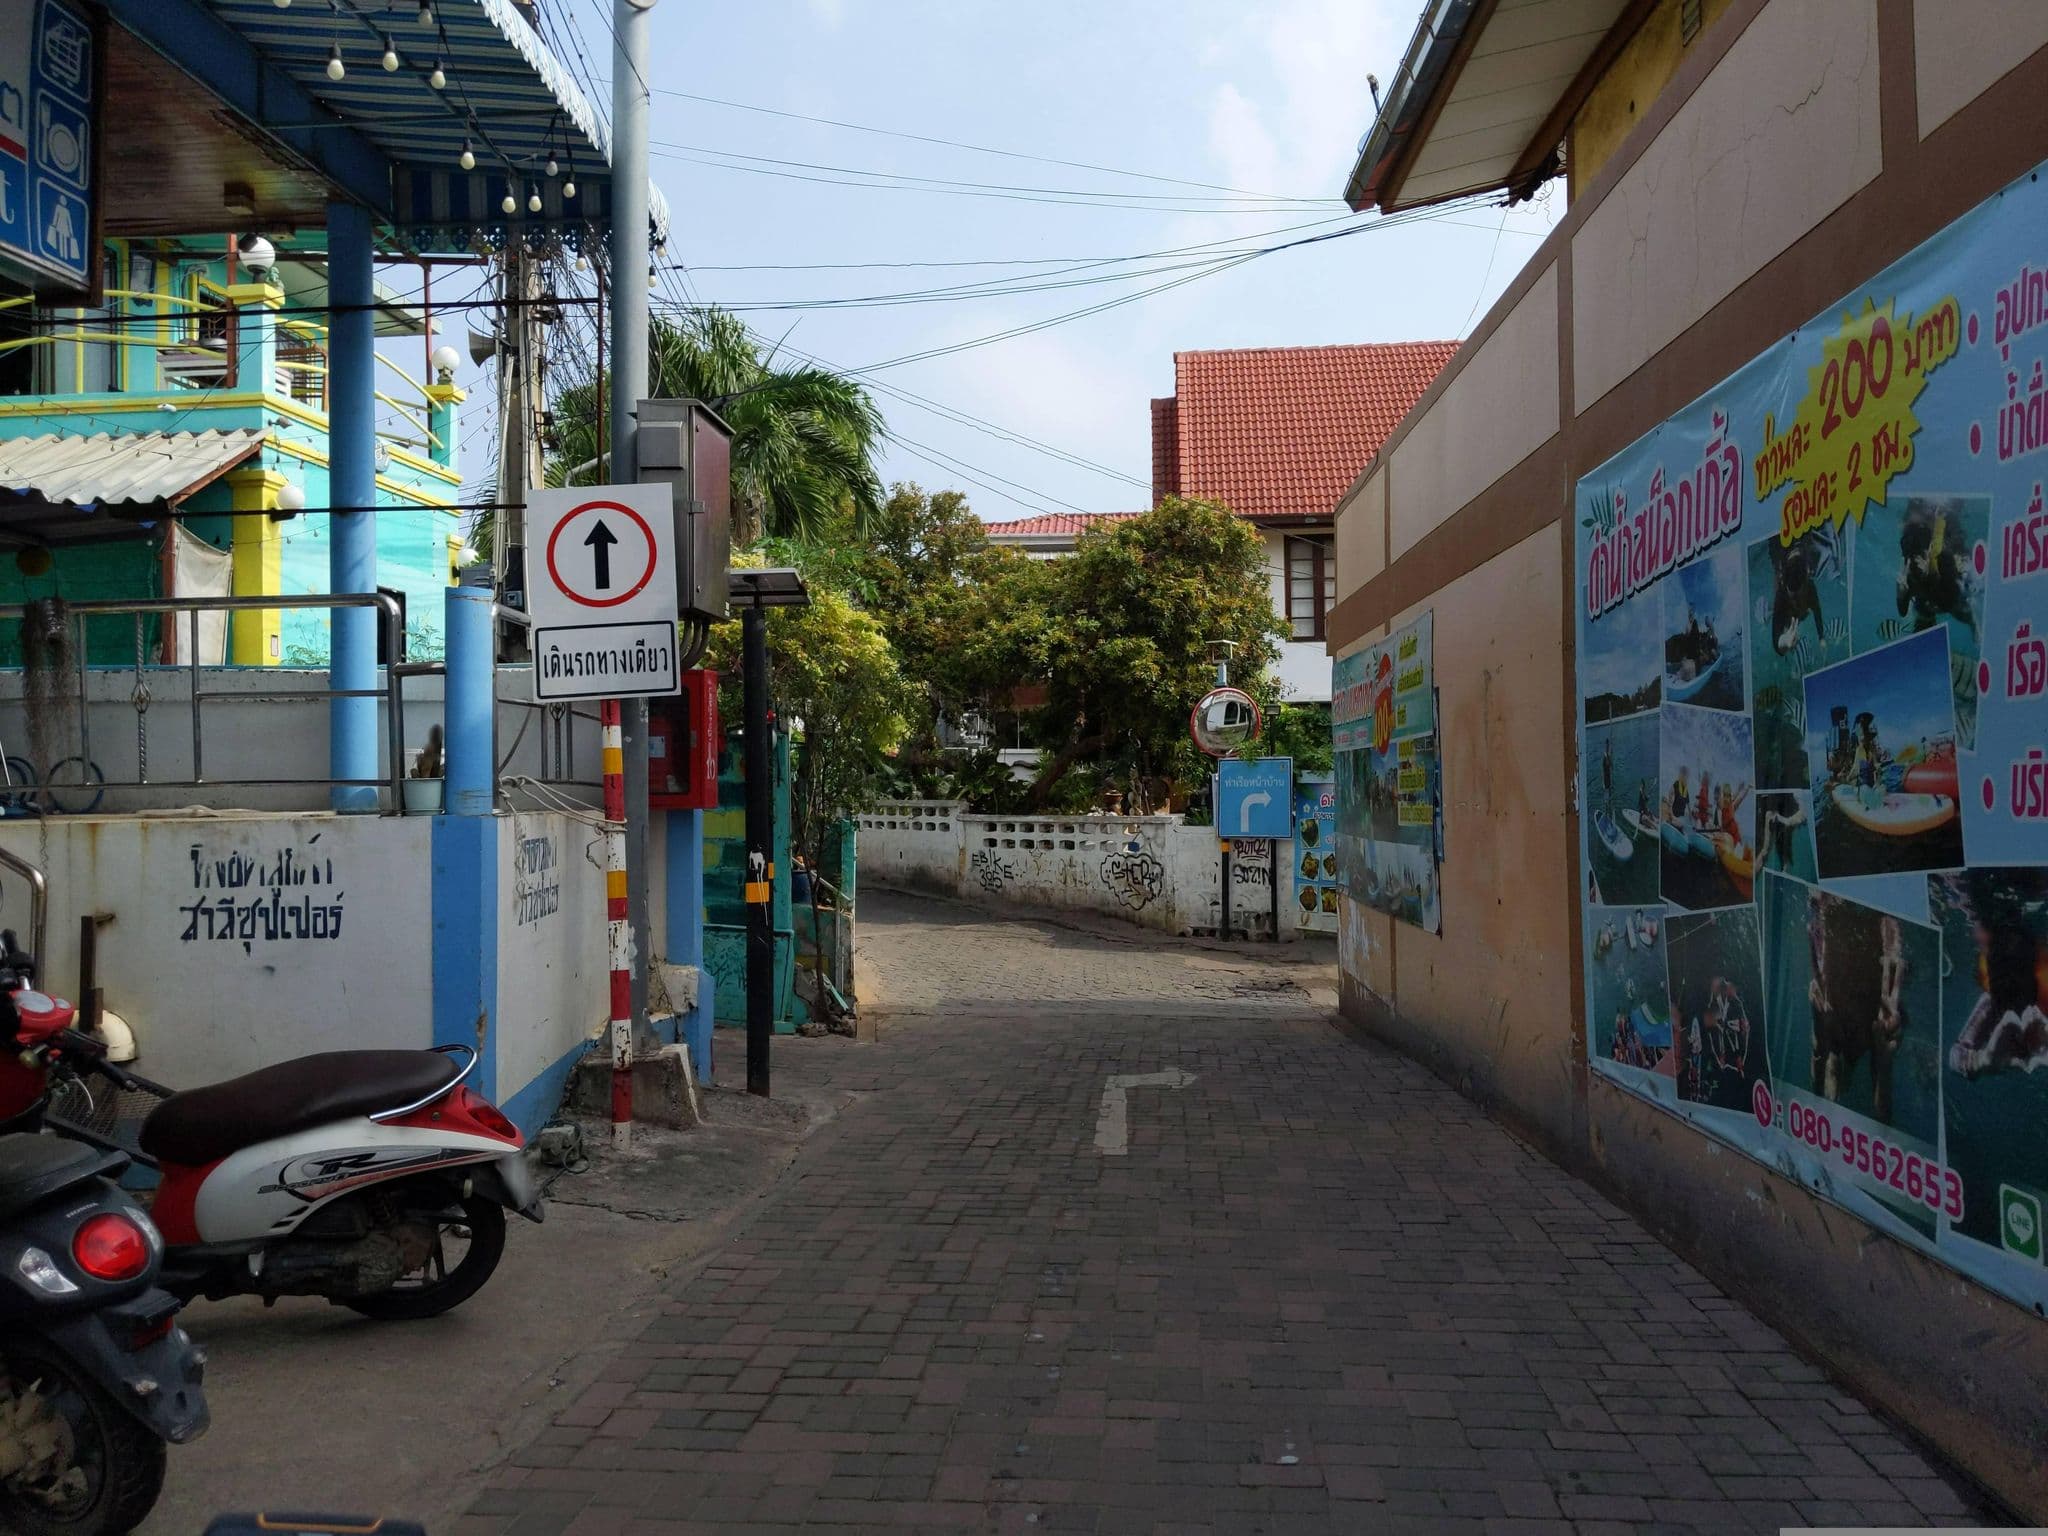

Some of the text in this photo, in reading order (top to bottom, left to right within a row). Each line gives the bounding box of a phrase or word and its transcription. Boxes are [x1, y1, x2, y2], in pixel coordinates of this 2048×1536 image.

[1755, 303, 1955, 491] ท่านละ 200 บาท
[1782, 420, 1909, 538] รอบละ 2 ชม.
[544, 638, 668, 679] เดินรถทางเดียว
[1790, 1102, 1963, 1218] 080-9562653
[2011, 1212, 2031, 1232] LINE
